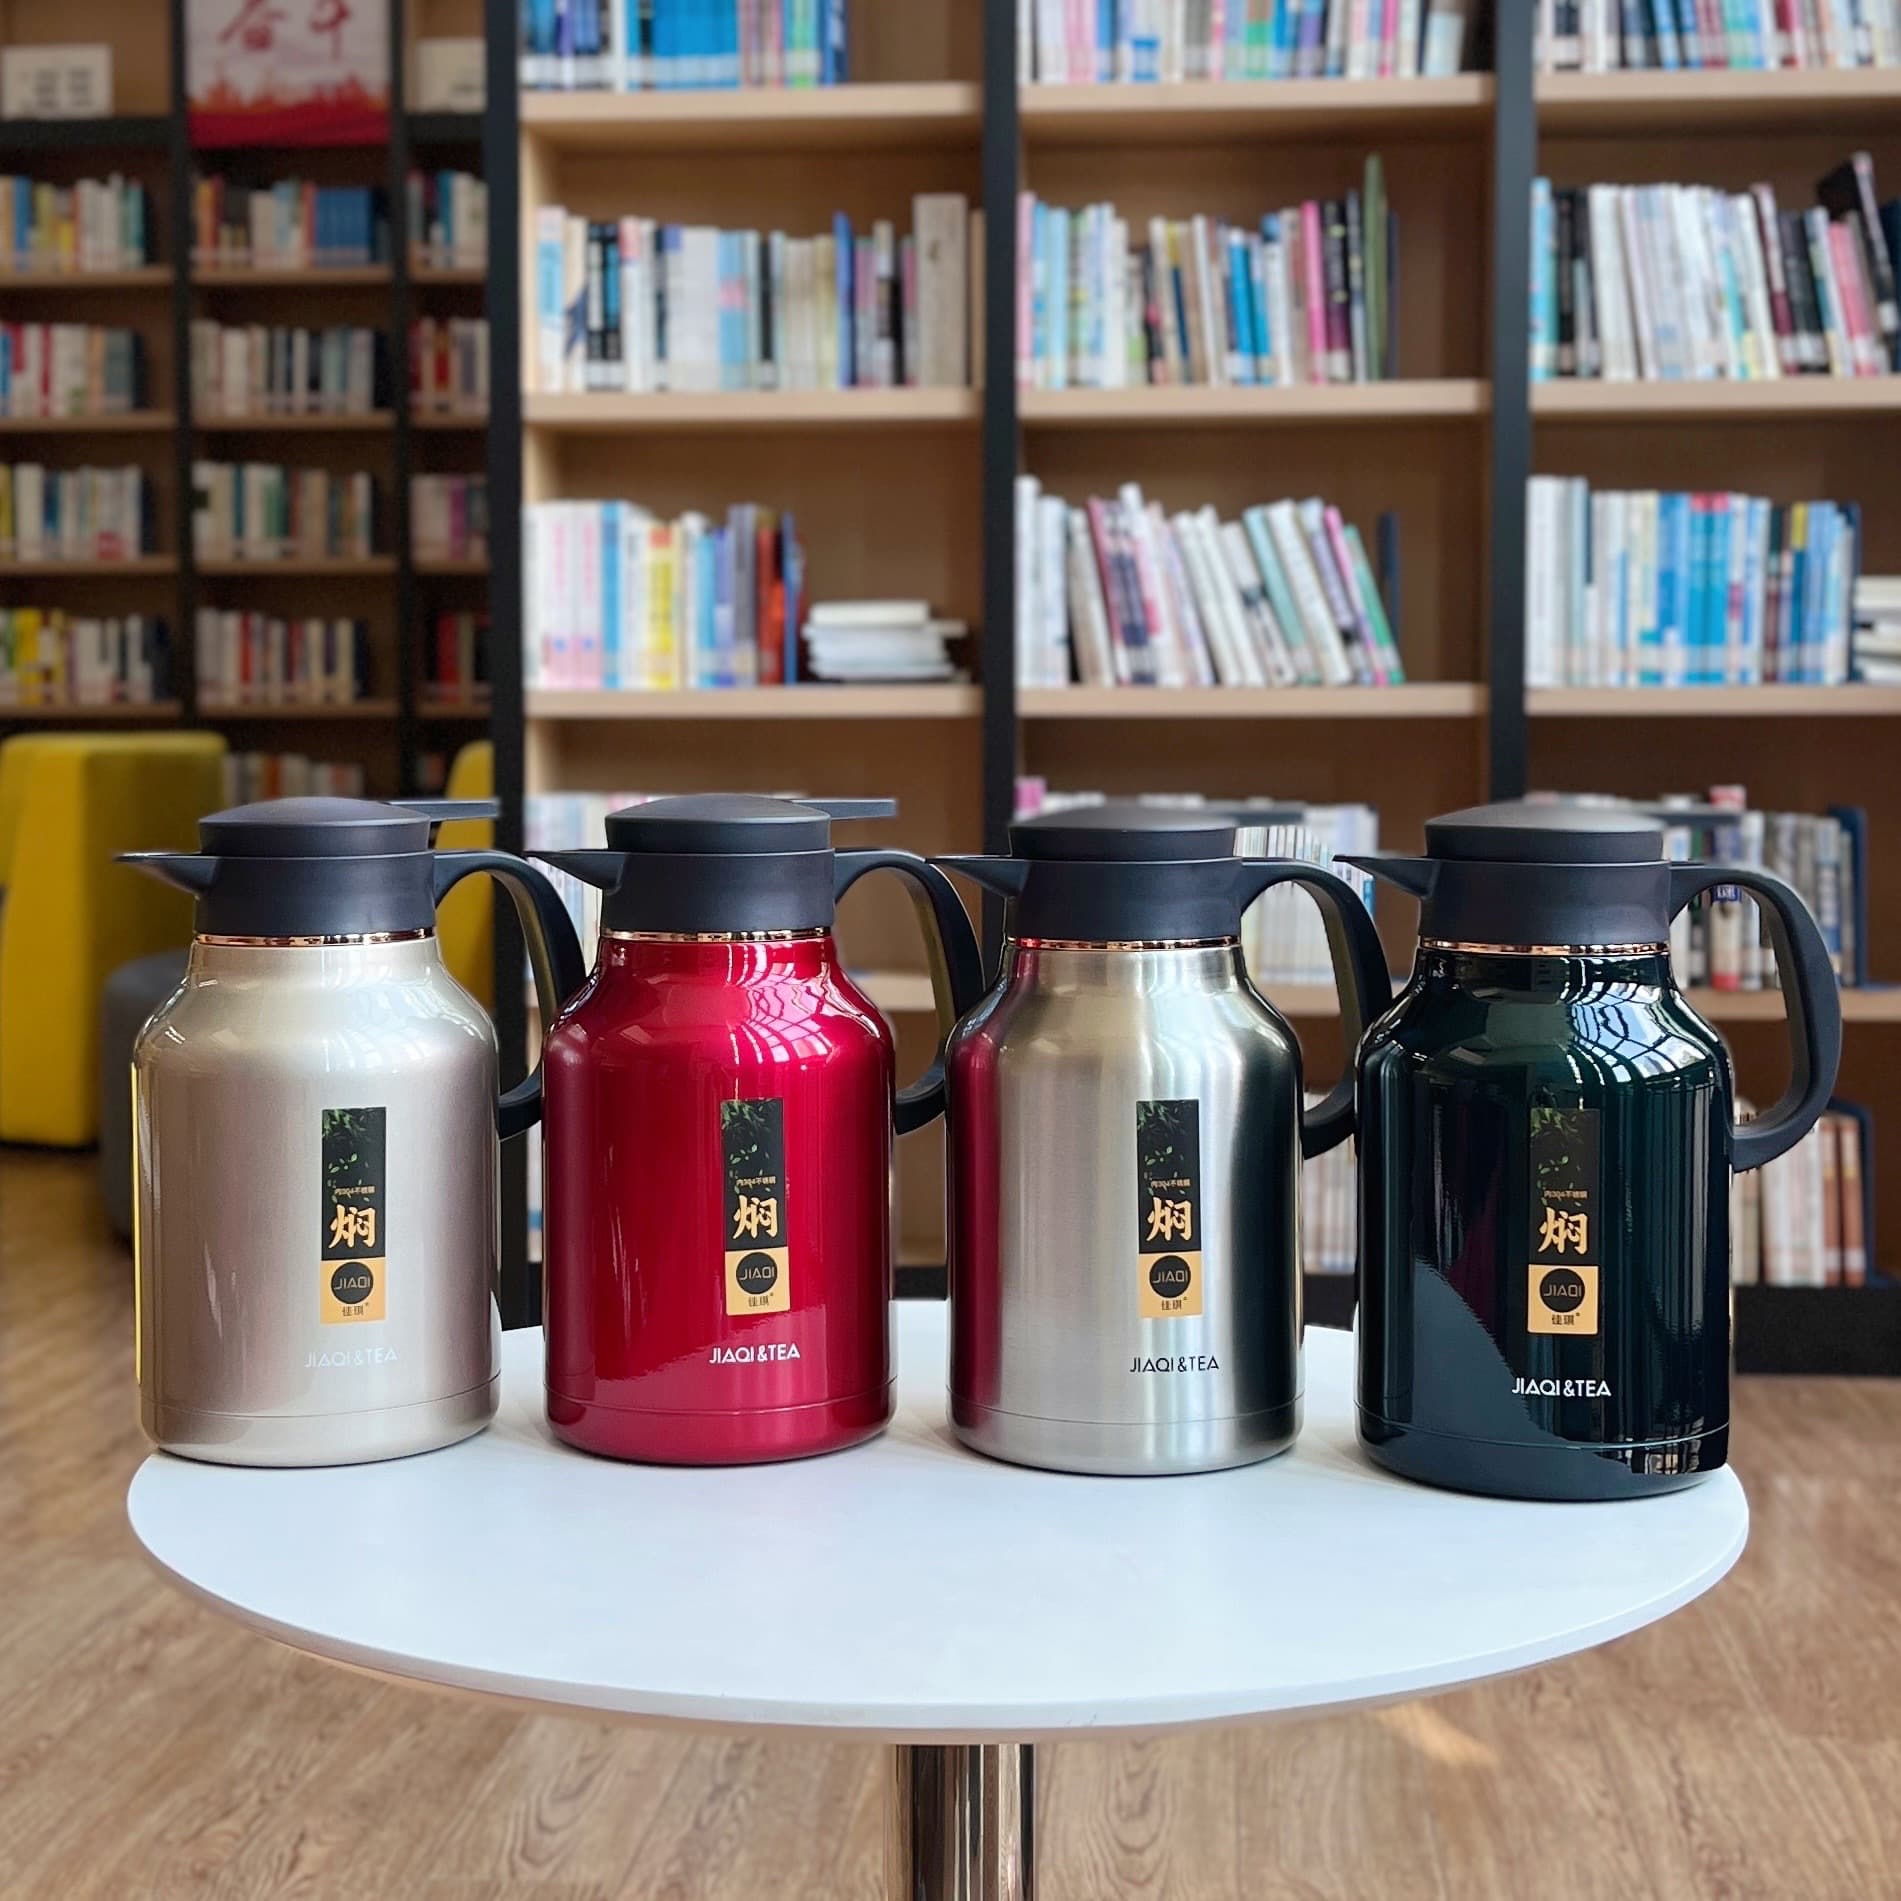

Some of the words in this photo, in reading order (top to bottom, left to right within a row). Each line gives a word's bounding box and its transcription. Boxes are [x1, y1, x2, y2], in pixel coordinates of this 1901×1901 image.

[328, 1204, 376, 1249] 焖
[733, 1195, 778, 1239] 焖
[1146, 1196, 1191, 1241] 焖
[1538, 1206, 1588, 1254] 焖
[333, 1276, 371, 1290] JIAQI
[739, 1266, 775, 1280] JIAQI
[1152, 1270, 1189, 1284] JIAQI
[1543, 1284, 1582, 1297] JIAQI
